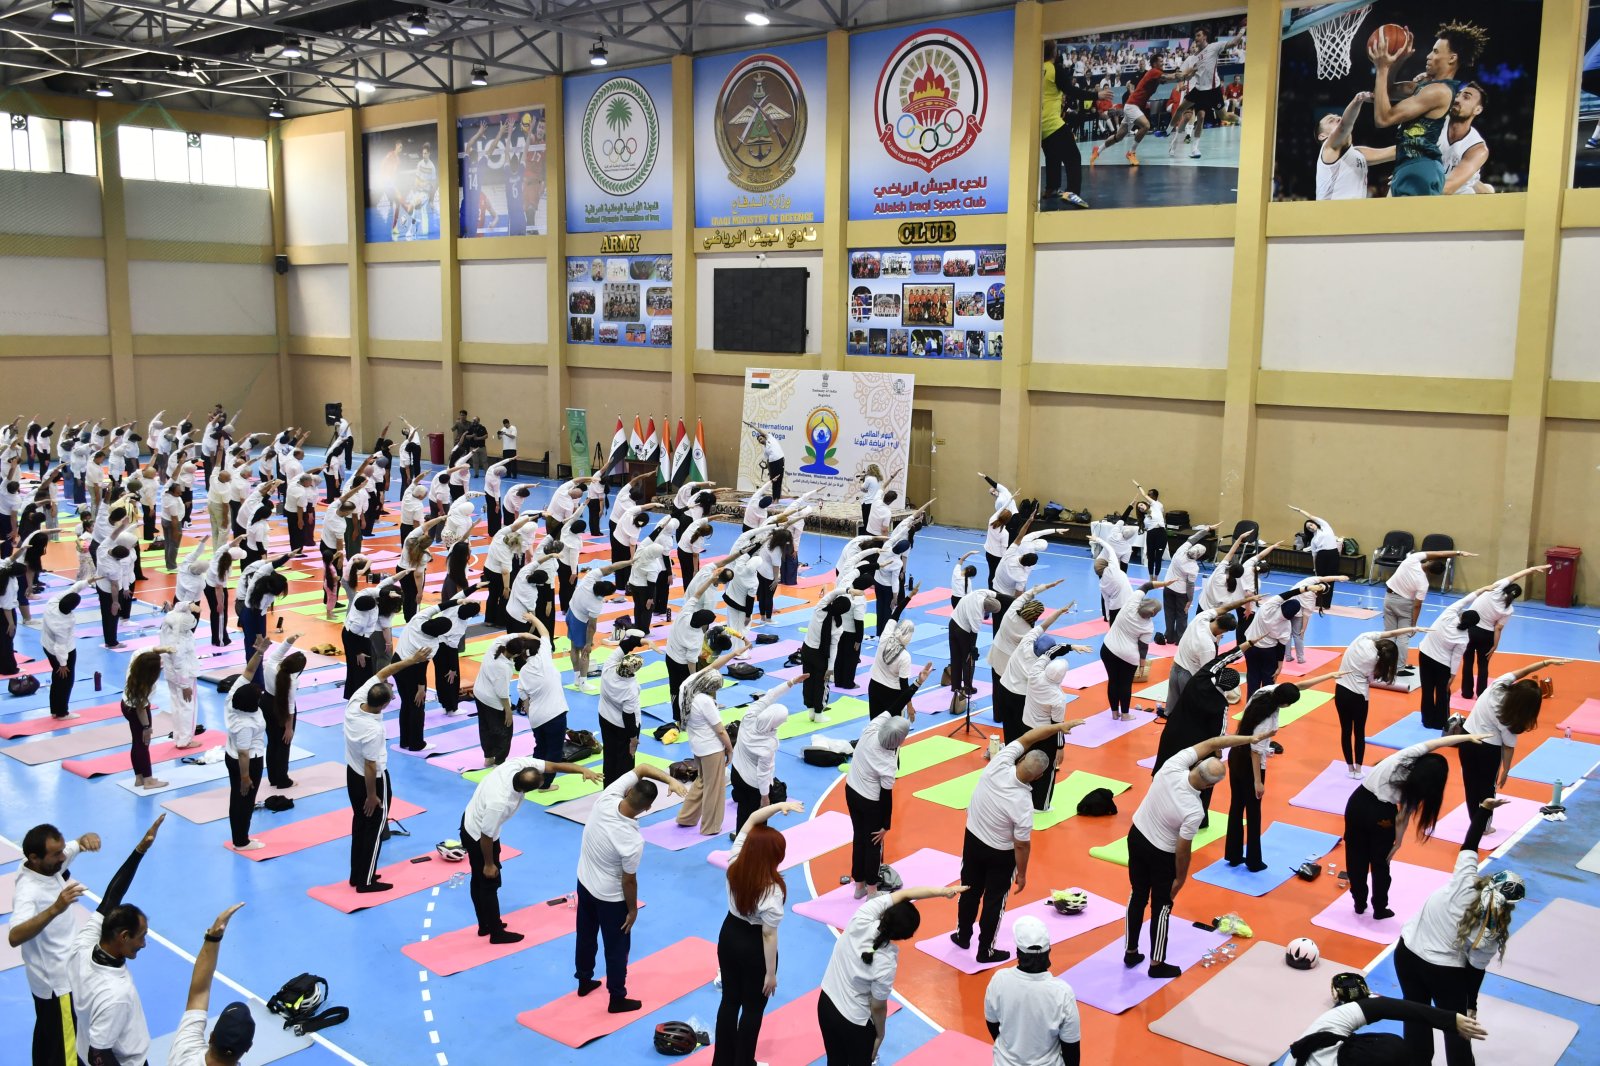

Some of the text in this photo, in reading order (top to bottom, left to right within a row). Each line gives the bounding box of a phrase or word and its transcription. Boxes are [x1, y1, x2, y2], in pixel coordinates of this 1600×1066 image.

[469, 174, 478, 190] 14
[874, 176, 987, 199] نادي الجيش الرياضي
[769, 194, 791, 209] وزارة
[909, 200, 931, 214] Iraqi
[934, 199, 961, 212] Sport
[963, 196, 986, 208] Club
[733, 214, 768, 225] MINISTRY
[770, 214, 778, 223] OF
[780, 212, 814, 222] DEFENCE
[703, 226, 817, 250] نادي الجيش الرياضي
[898, 221, 956, 245] CLUB
[601, 234, 641, 253] ARMY
[758, 422, 793, 431] International
[854, 438, 868, 446] اليوغا
[861, 430, 879, 439] العالمي
[869, 439, 886, 448] لرياضة
